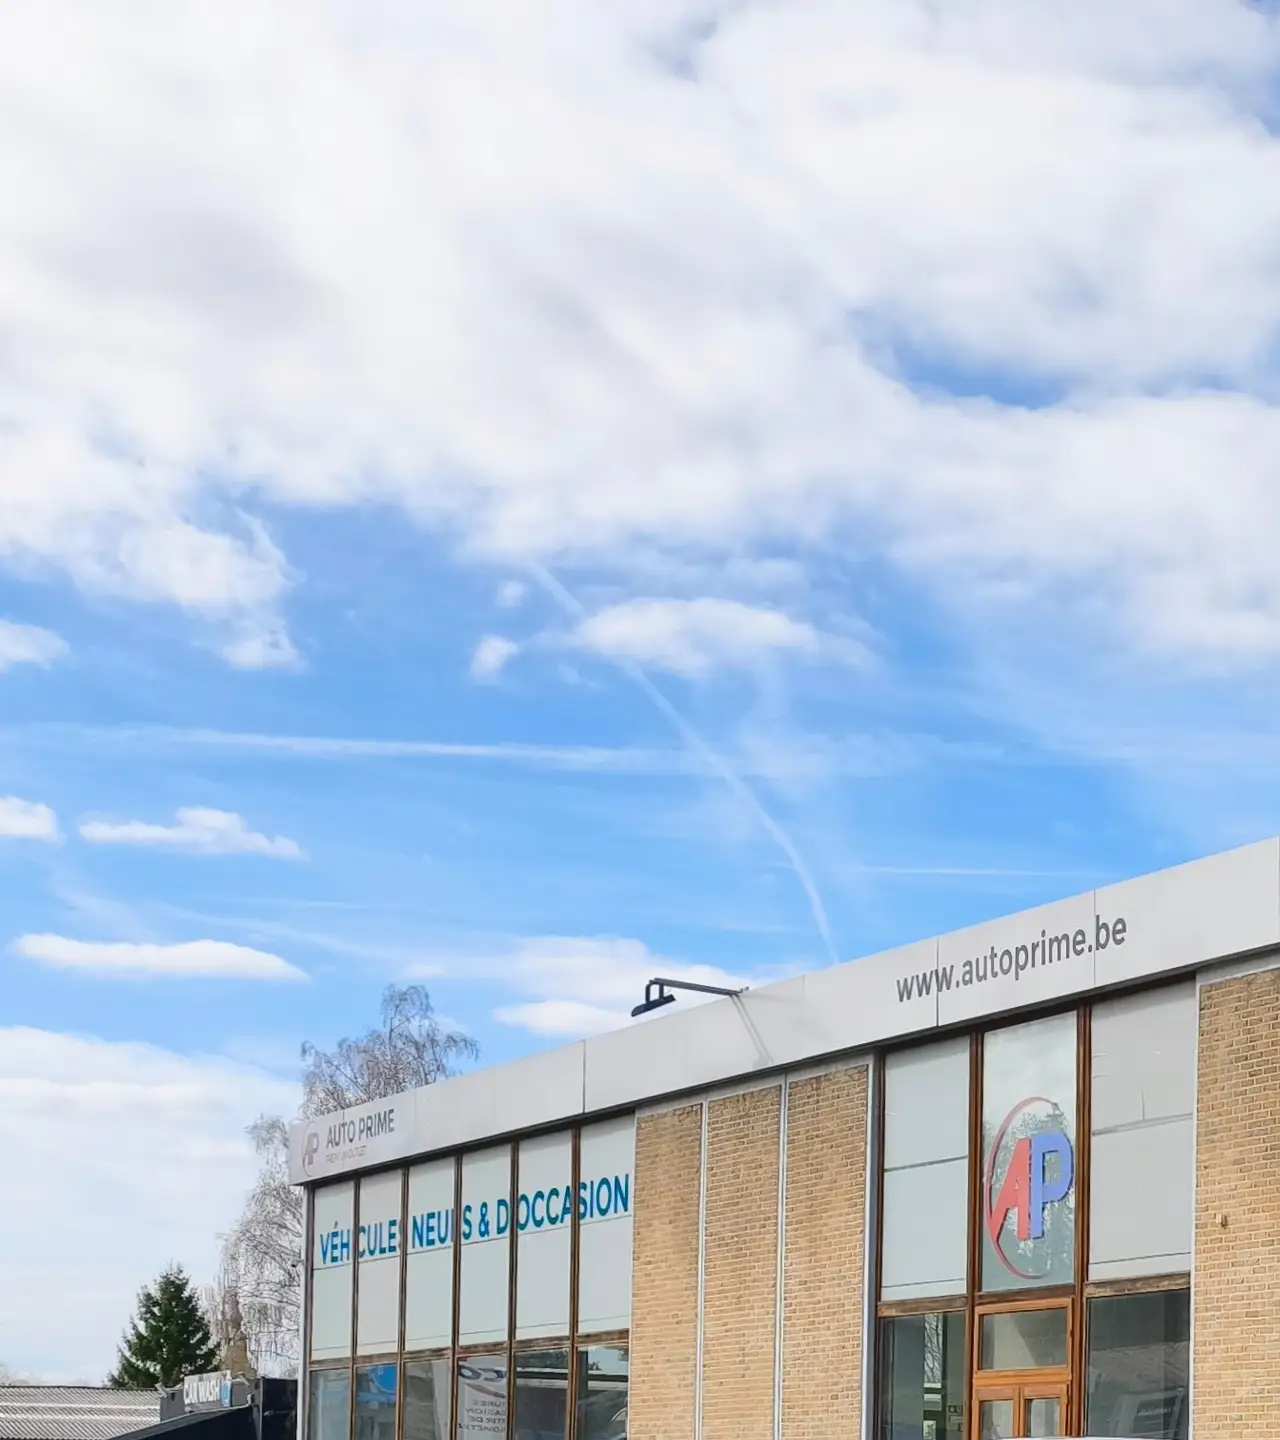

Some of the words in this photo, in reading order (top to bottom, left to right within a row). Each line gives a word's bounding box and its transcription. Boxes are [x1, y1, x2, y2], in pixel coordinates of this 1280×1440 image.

[896, 914, 1127, 1002] www.autoprime.be
[326, 1120, 356, 1149] AUTO
[358, 1108, 395, 1141] PRIME
[320, 1219, 401, 1265] VÉHCULE
[478, 1201, 490, 1237] &
[496, 1173, 630, 1235] DOCCASION
[199, 1378, 221, 1403] WASH
